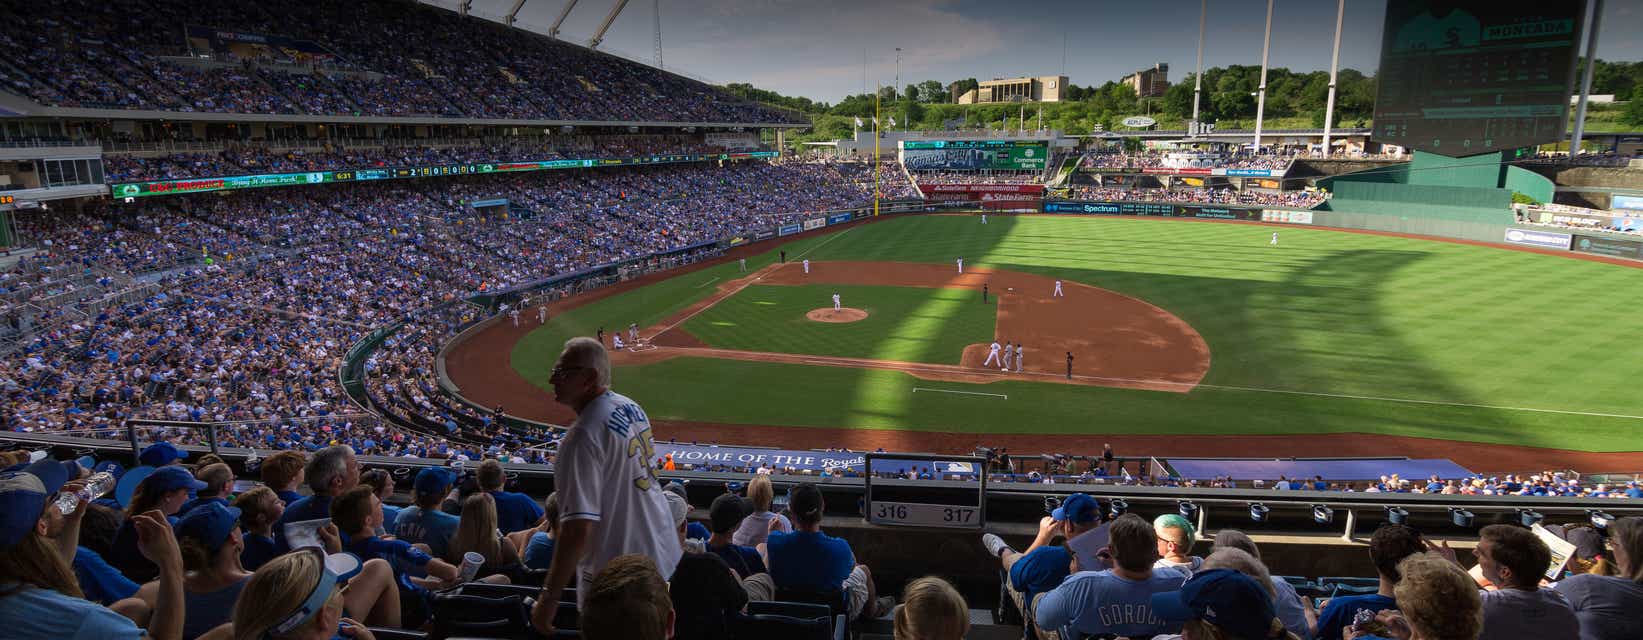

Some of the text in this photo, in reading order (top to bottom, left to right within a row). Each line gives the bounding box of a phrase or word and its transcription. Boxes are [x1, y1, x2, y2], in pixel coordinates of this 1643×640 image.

[1084, 204, 1118, 213] Spectrum
[671, 450, 733, 462] HOME
[738, 454, 767, 463] OF
[773, 455, 815, 466] THE
[877, 503, 974, 523] 316 317
